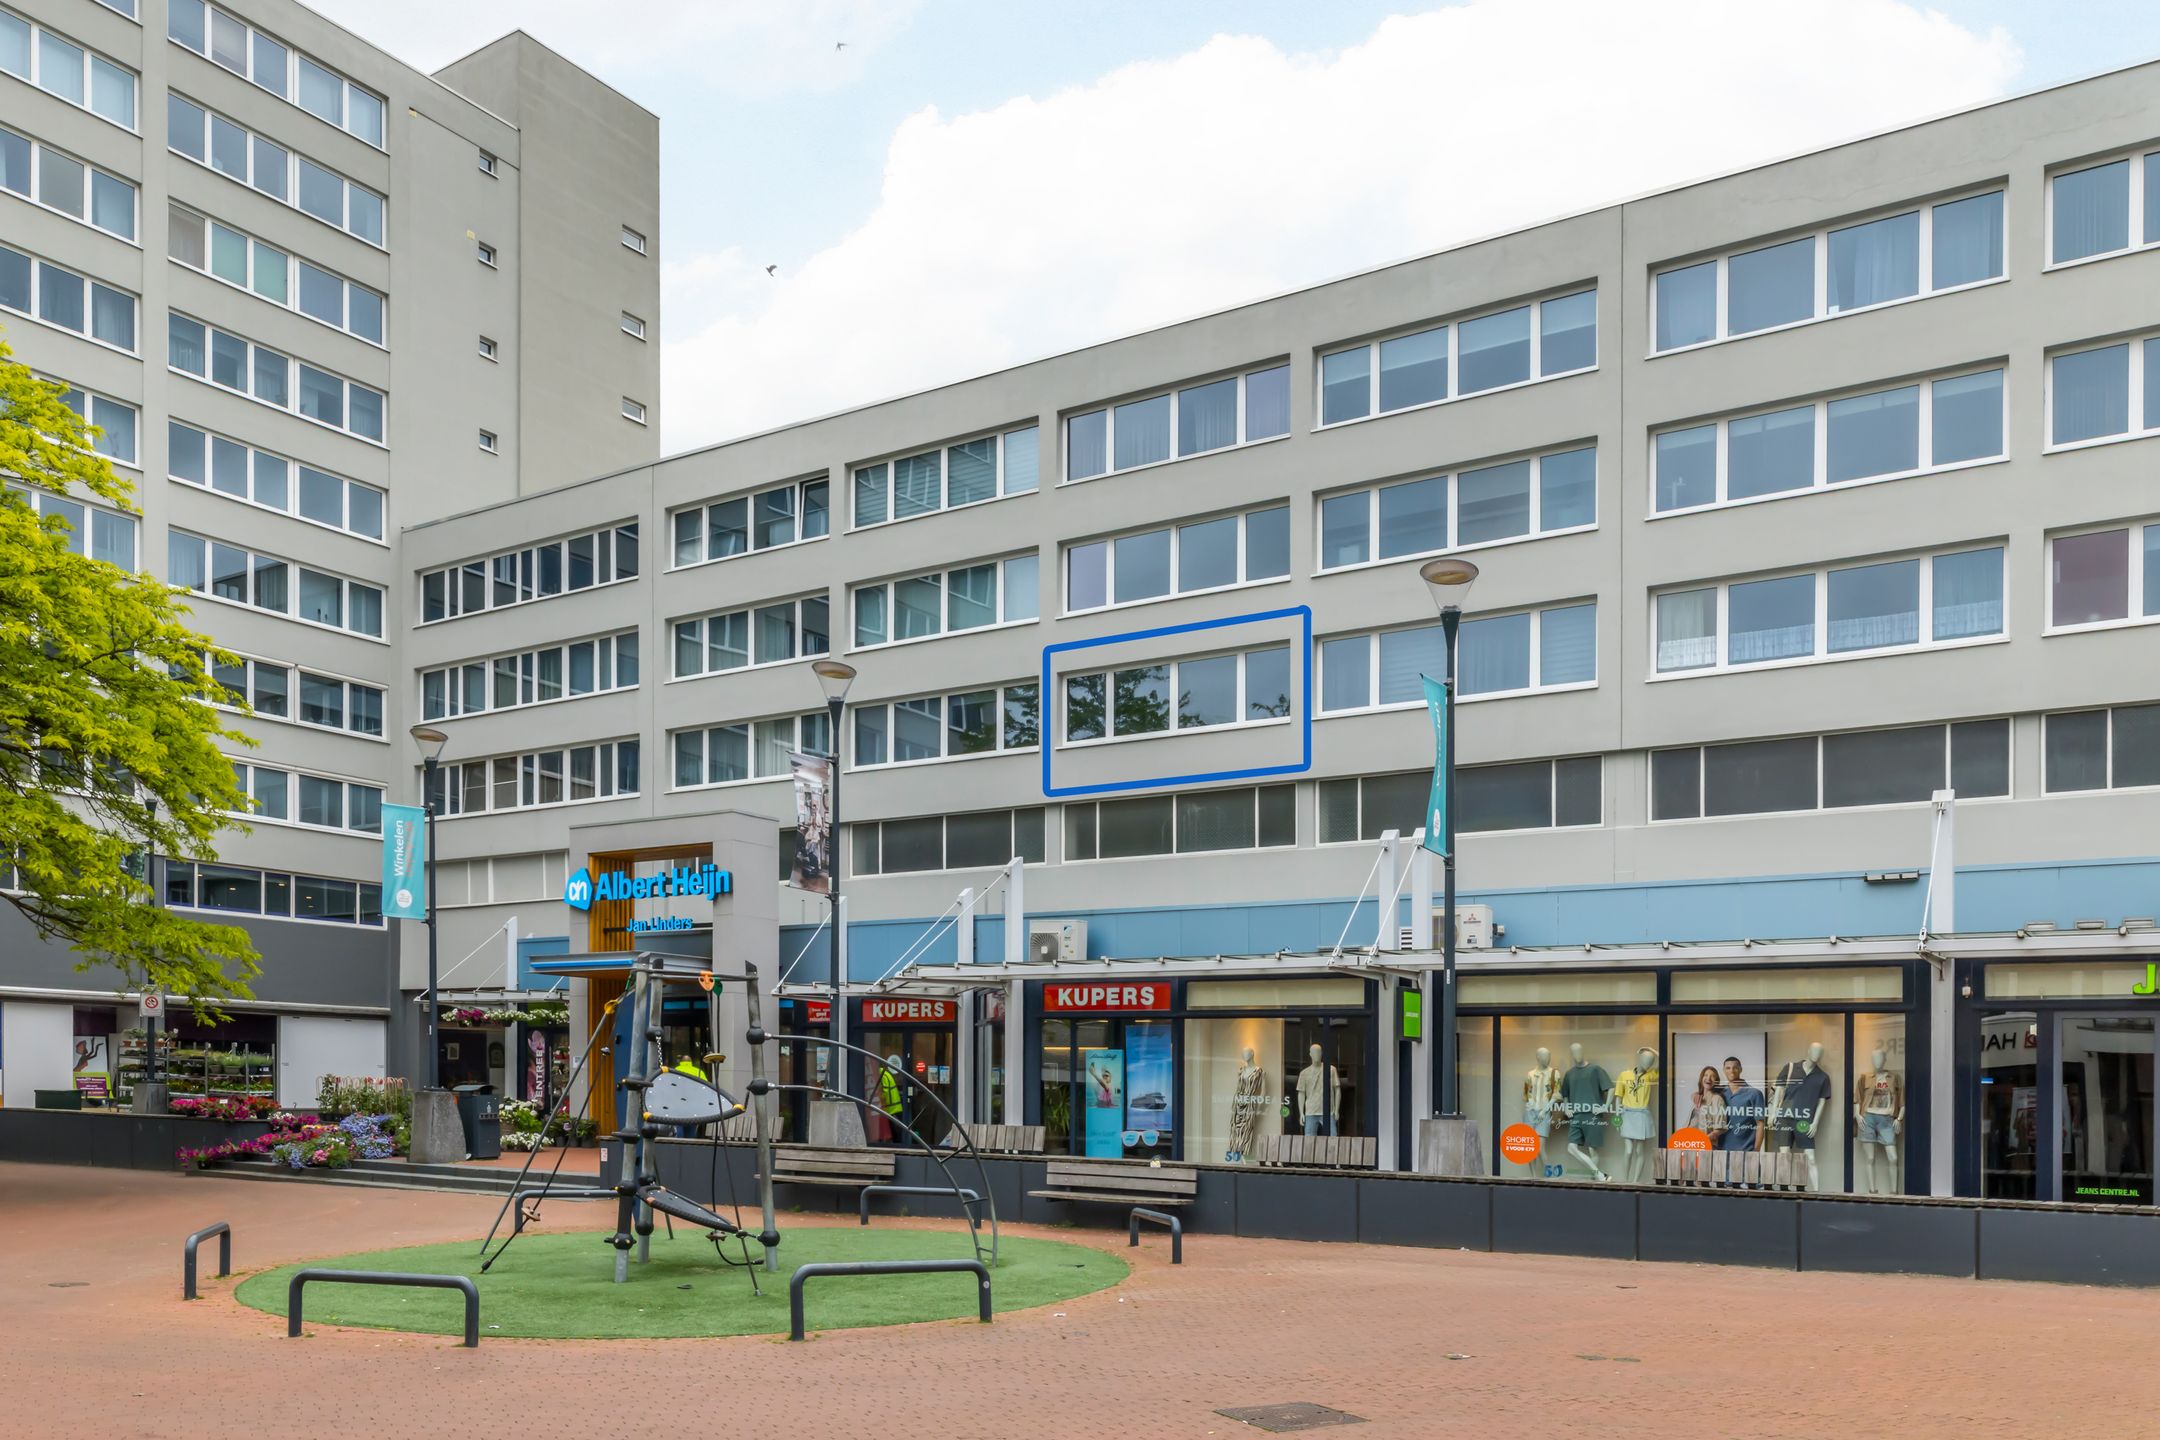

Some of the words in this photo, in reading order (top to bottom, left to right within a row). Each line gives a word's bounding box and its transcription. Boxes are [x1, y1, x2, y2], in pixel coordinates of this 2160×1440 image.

[394, 820, 404, 877] Winkelen
[594, 870, 667, 901] Albert
[671, 864, 731, 901] Heijn
[626, 918, 647, 932] Jan
[649, 915, 693, 931] Linders
[1057, 986, 1155, 1006] KUPERS
[871, 1001, 945, 1018] KUPERS
[536, 1049, 545, 1098] ENTREE
[1734, 1121, 1760, 1134] zomer
[1505, 1135, 1535, 1144] SHORTS
[1673, 1140, 1706, 1149] SHORTS
[2075, 1187, 2099, 1195] JEANS
[2099, 1188, 2140, 1197] CENTRE.NL
